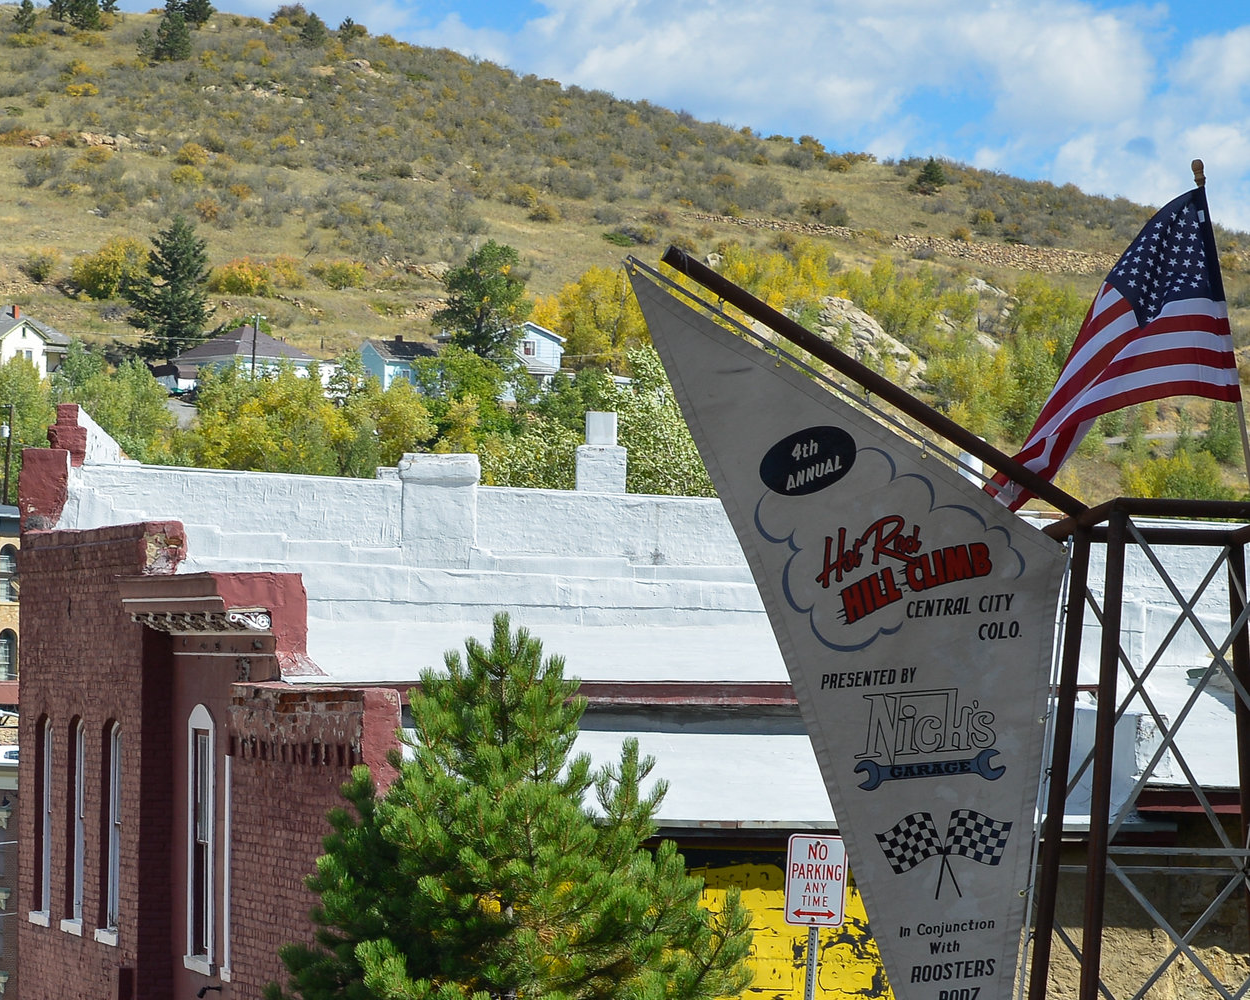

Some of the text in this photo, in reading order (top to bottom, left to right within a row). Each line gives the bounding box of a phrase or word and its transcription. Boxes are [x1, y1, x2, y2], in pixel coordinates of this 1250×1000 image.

[791, 439, 818, 460] 4th
[786, 456, 842, 491] ANNUAL
[816, 514, 923, 588] Hot Rod
[840, 542, 993, 625] HILL CLIMB
[906, 593, 1014, 619] CENTRAL CITY
[978, 621, 1022, 641] COLO.
[821, 666, 917, 690] PRESENTED BY
[889, 760, 972, 779] GARAGE
[808, 844, 828, 861] NO
[791, 862, 842, 882] PARKING
[804, 882, 827, 894] ANY
[801, 895, 829, 908] TIME
[899, 919, 995, 938] In Conjunction
[929, 940, 960, 955] With
[911, 958, 996, 984] ROOSTERS
